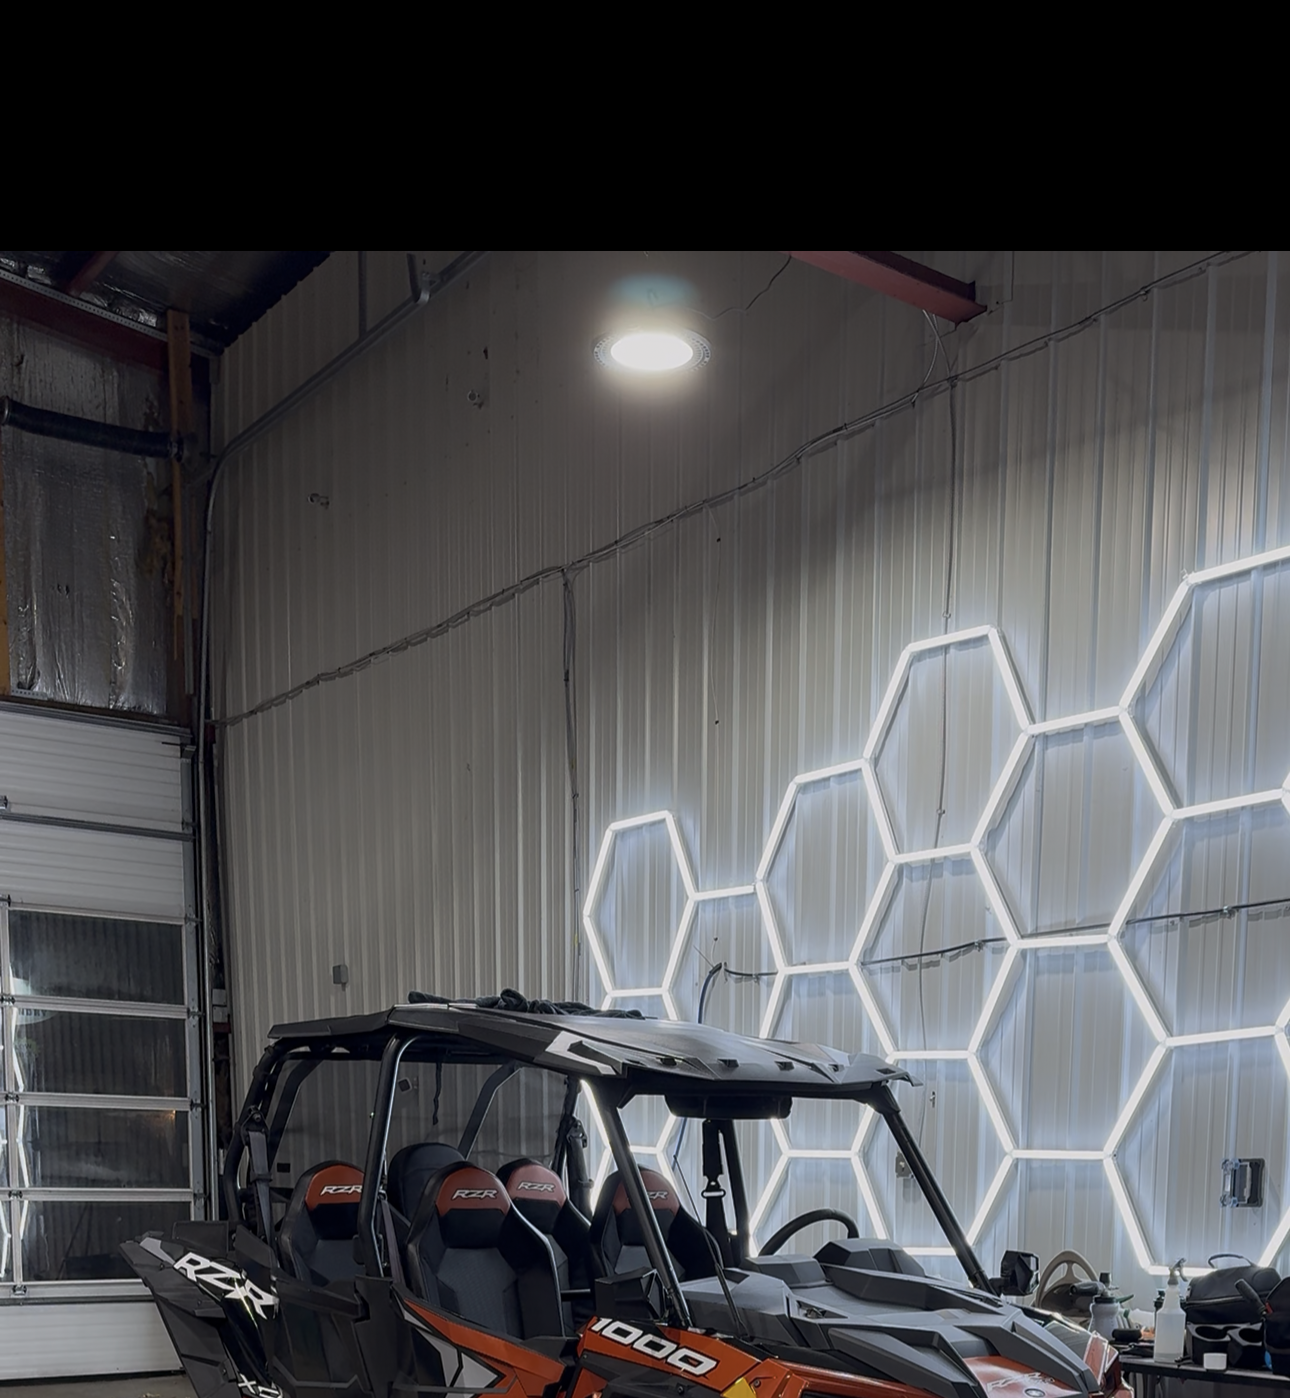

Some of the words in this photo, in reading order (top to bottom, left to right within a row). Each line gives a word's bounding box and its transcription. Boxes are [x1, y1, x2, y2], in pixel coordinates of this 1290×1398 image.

[320, 1184, 362, 1196] RZR
[517, 1181, 556, 1193] RZR
[451, 1188, 498, 1200] RZR
[173, 1251, 280, 1320] RZR
[591, 1317, 718, 1377] 1000
